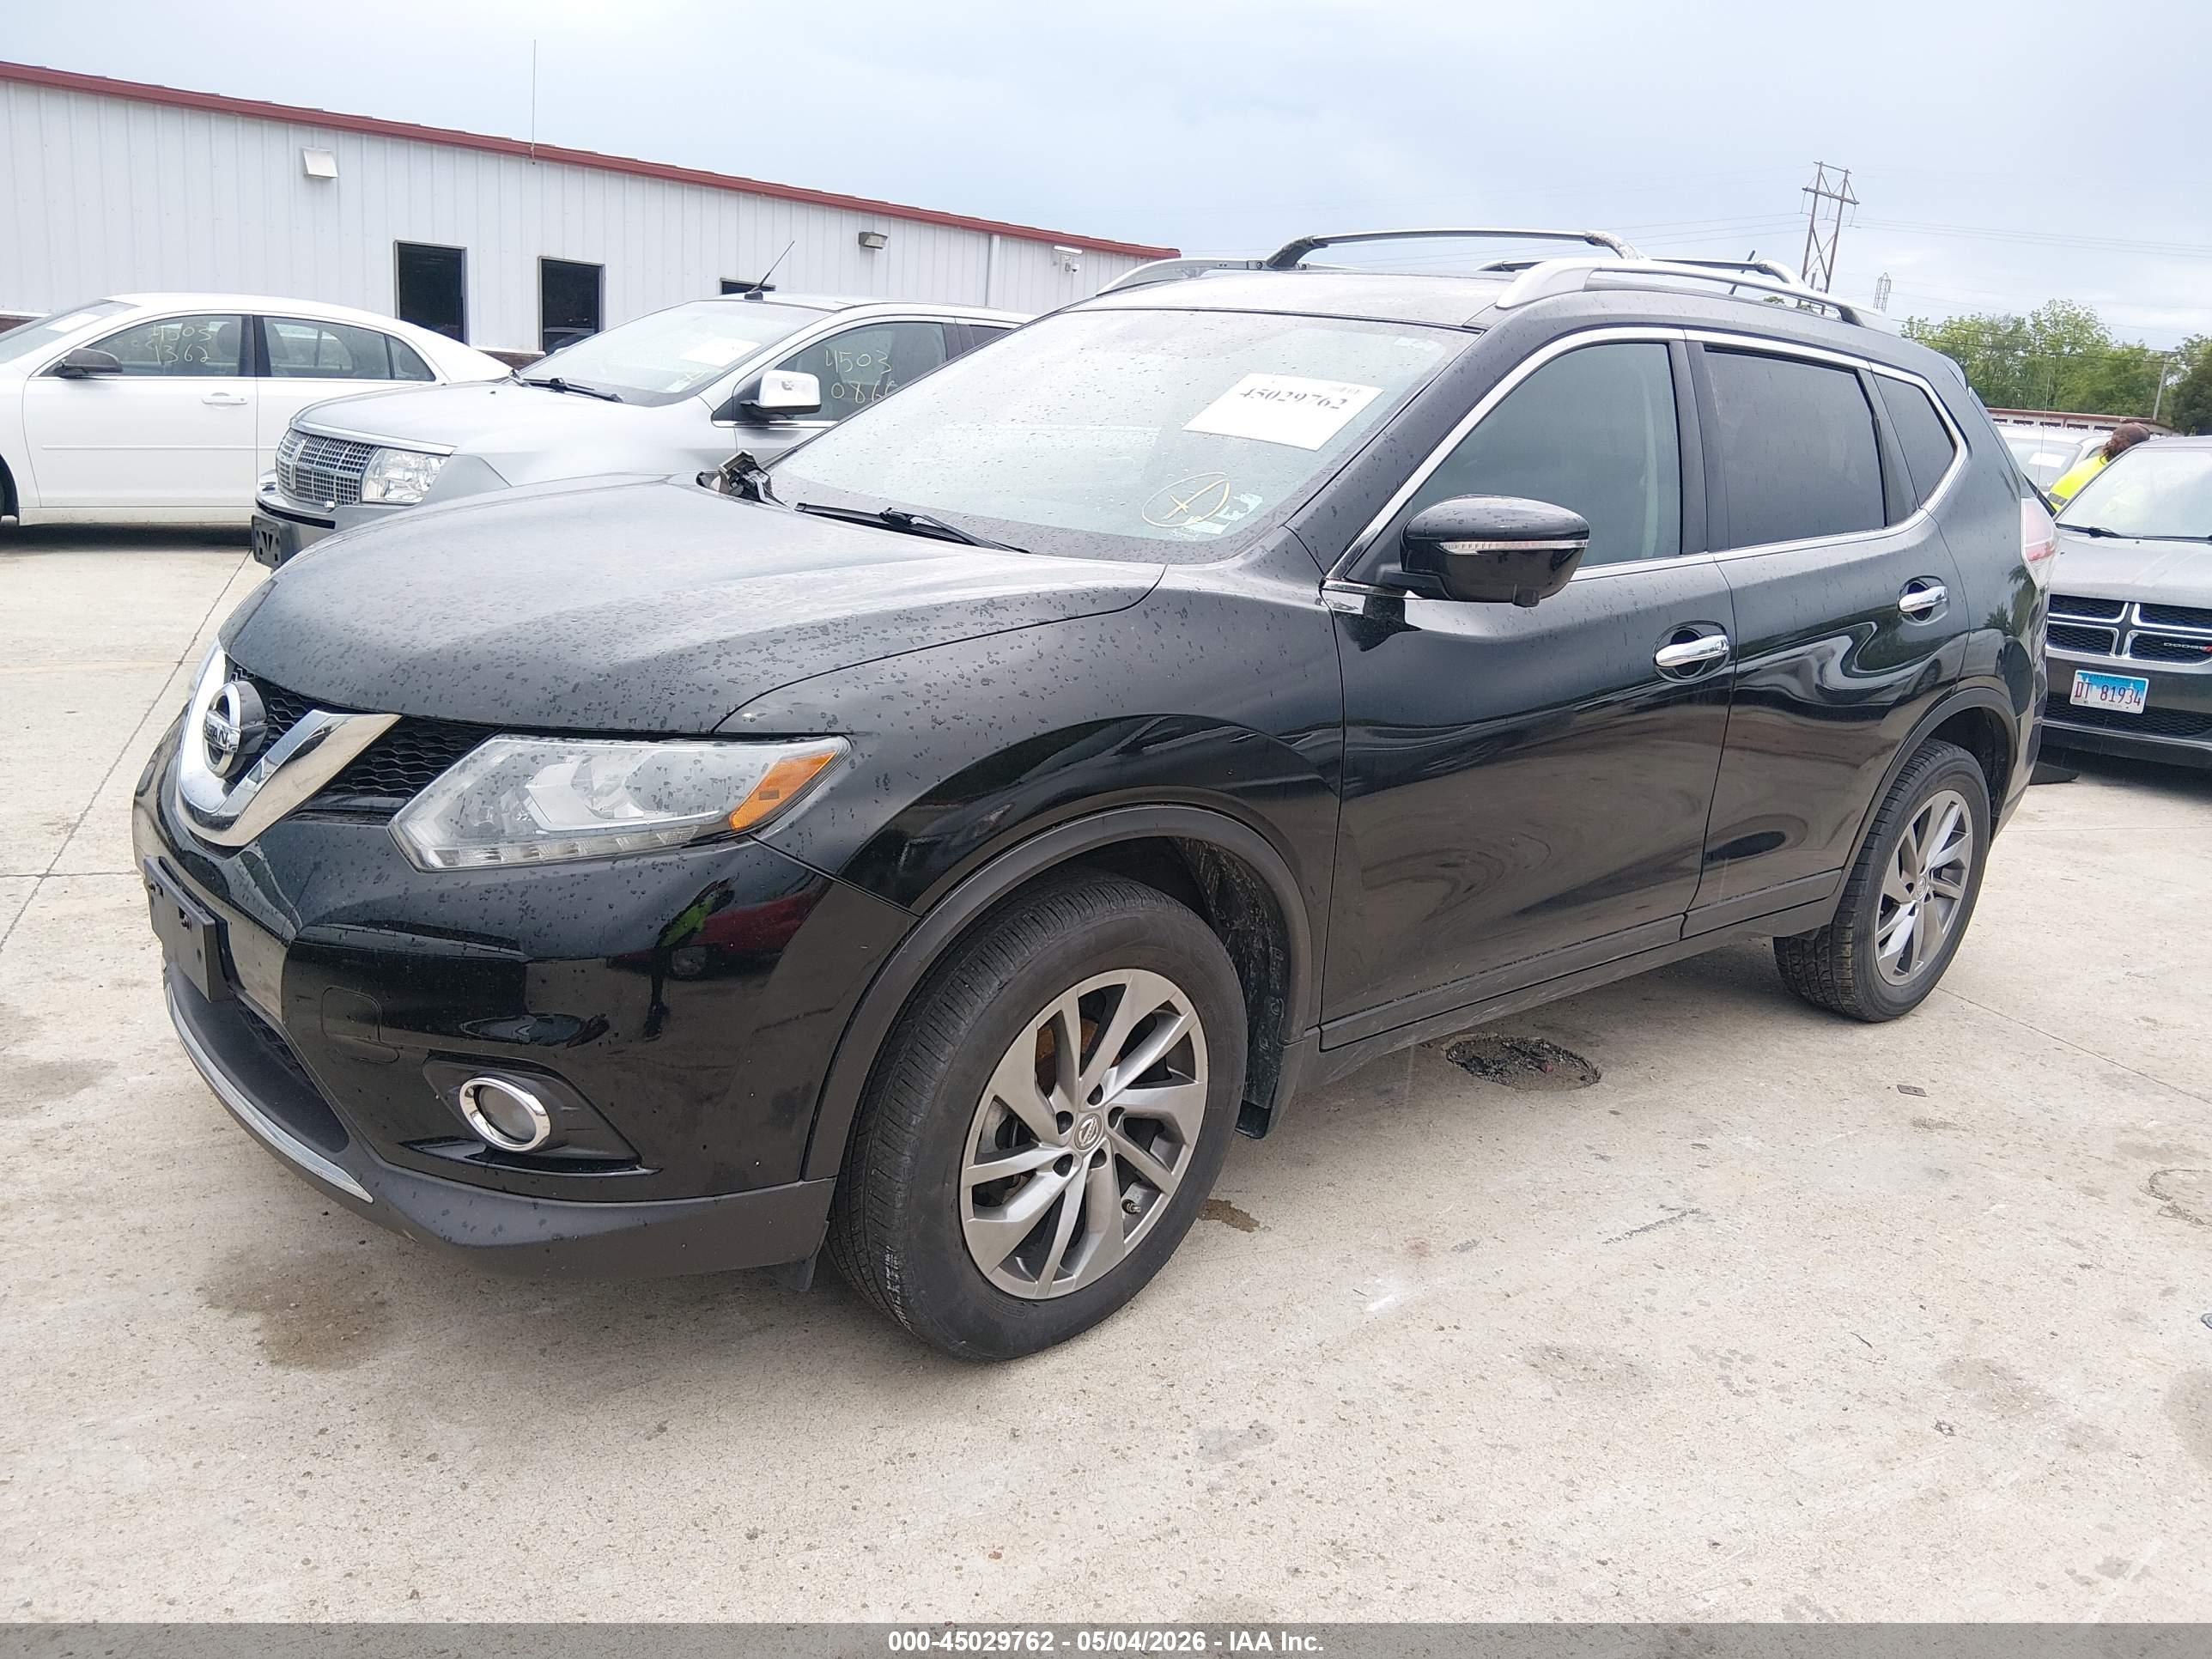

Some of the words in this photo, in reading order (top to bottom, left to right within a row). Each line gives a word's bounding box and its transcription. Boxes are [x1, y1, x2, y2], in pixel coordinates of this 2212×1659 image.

[155, 343, 210, 364] 1362
[825, 349, 892, 374] 4503
[1239, 387, 1348, 410] 45029762
[2100, 684, 2142, 706] 81934
